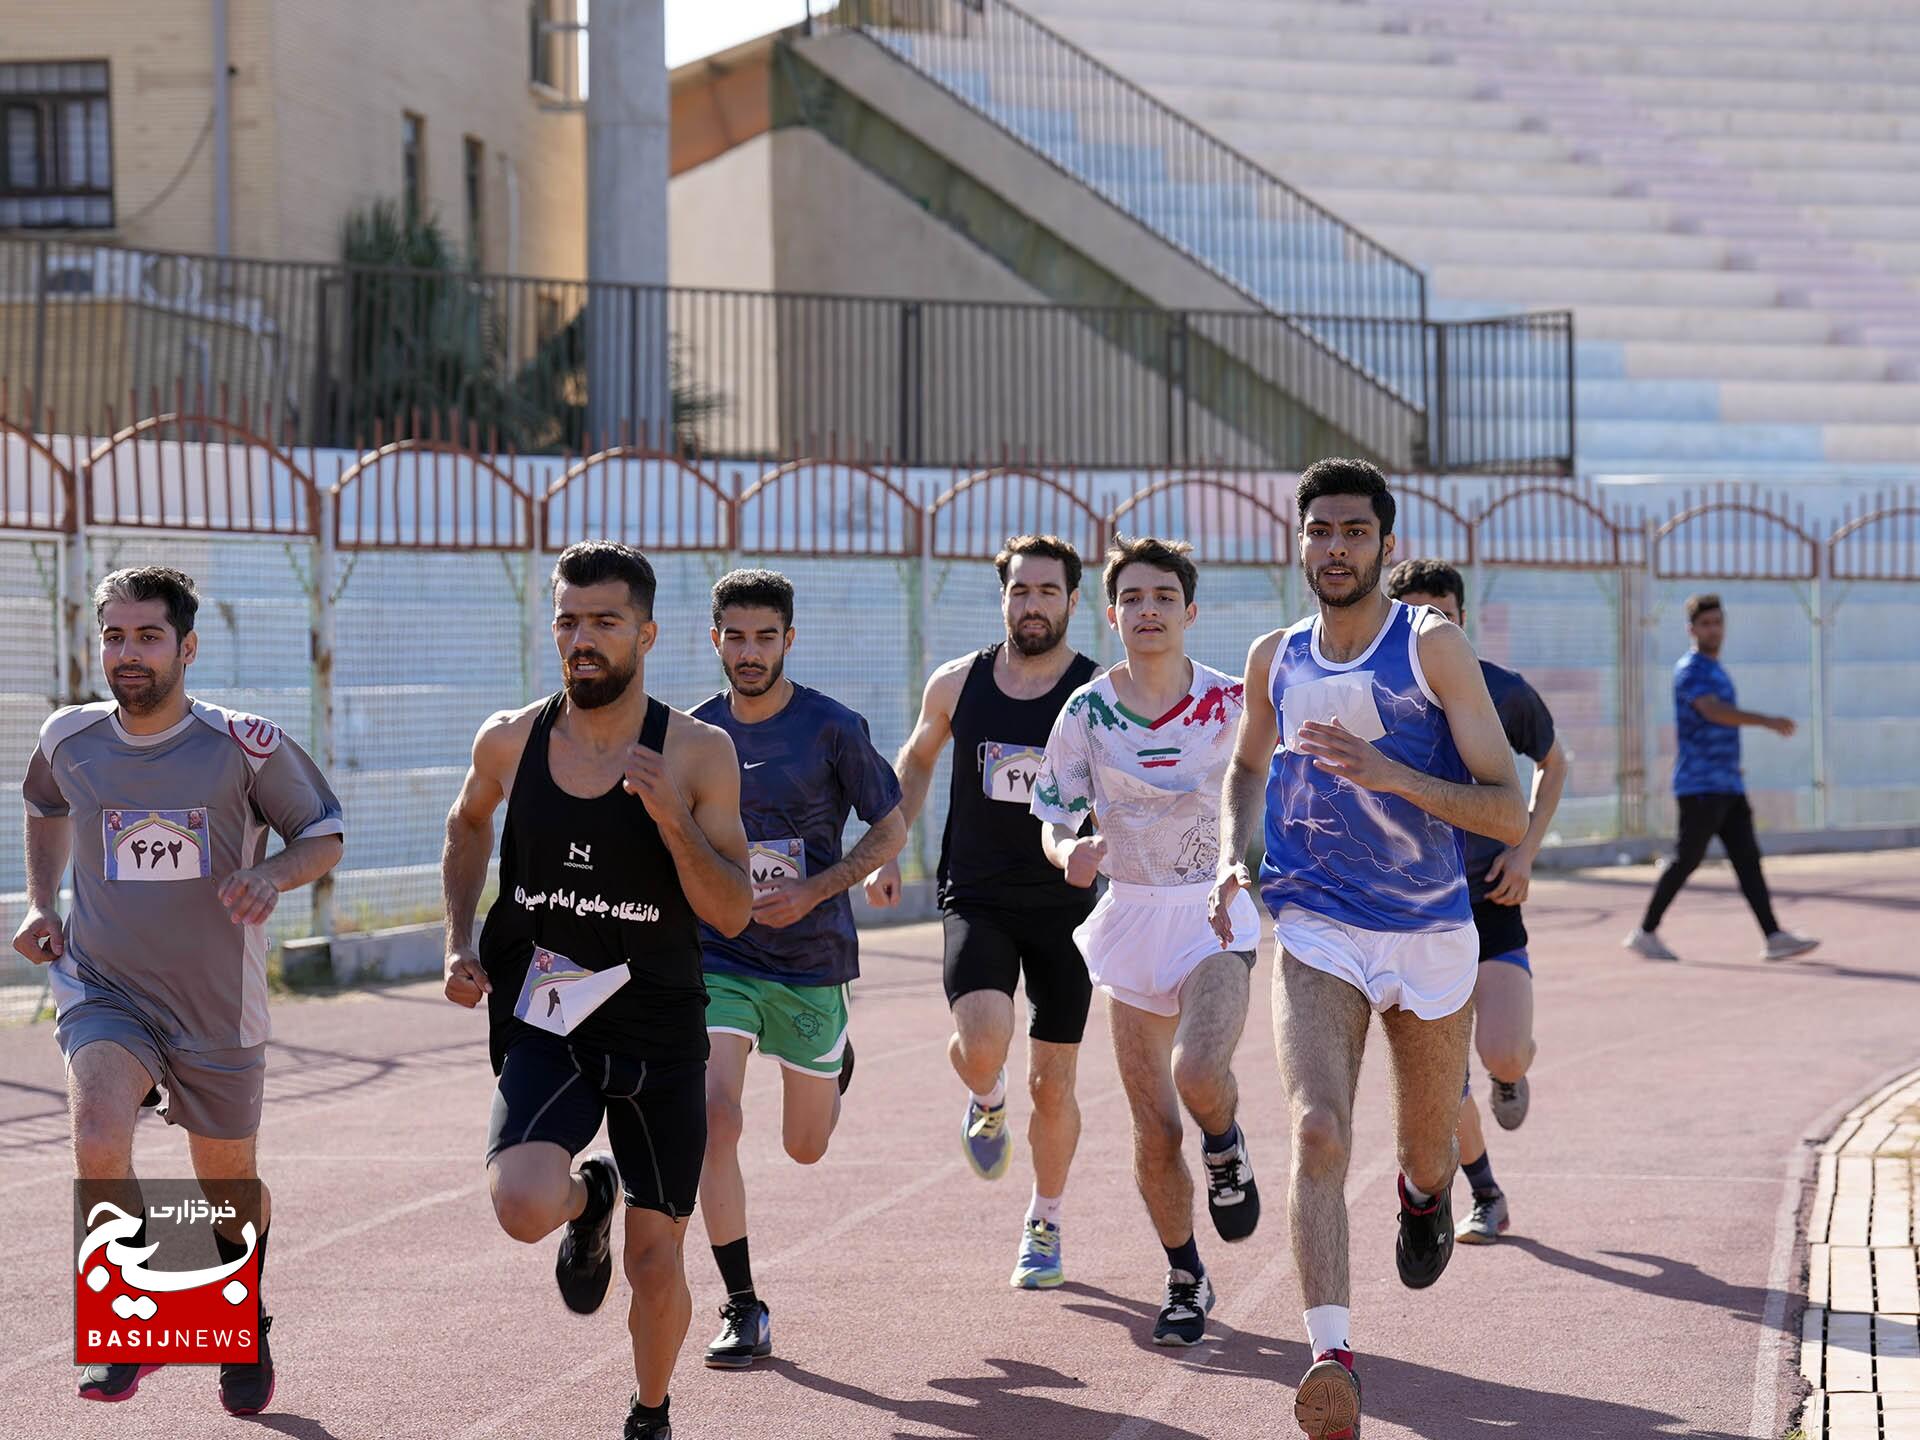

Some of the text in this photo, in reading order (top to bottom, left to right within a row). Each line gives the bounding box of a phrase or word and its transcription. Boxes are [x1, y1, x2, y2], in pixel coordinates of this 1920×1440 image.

[1006, 768, 1037, 794] ۴۷
[131, 840, 182, 869] ۴۶۲
[549, 888, 575, 910] امام
[575, 894, 610, 918] جامع
[611, 901, 660, 922] دانشگاه
